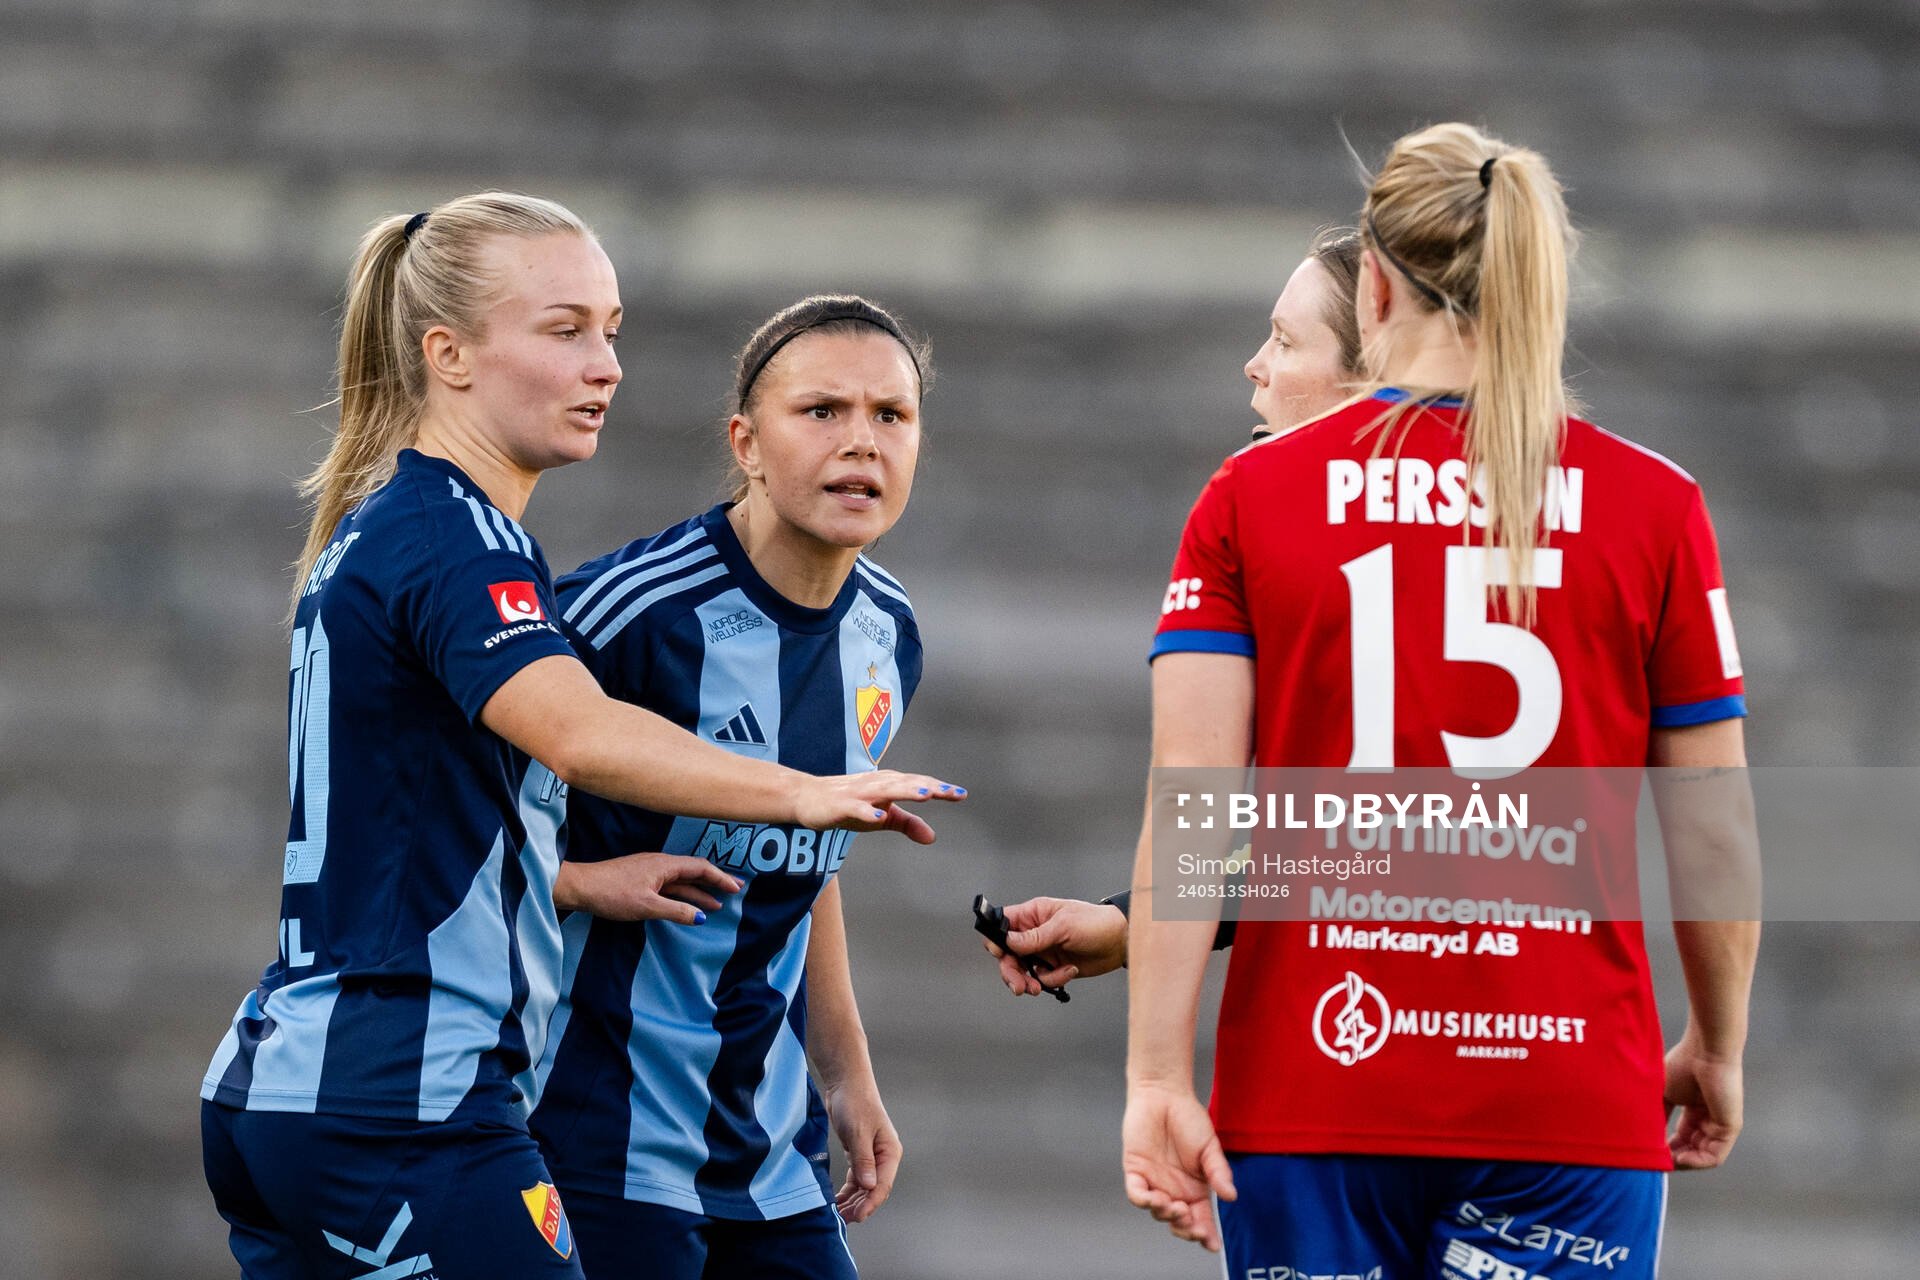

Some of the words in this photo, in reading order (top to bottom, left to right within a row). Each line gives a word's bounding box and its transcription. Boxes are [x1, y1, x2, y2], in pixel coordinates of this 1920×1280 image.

[1327, 458, 1584, 533] PERSSN
[484, 622, 547, 648] SVENSKA
[707, 617, 763, 644] WELLNESS
[708, 610, 748, 631] NORDIC
[860, 610, 890, 640] NORDIC
[1340, 542, 1563, 780] 15
[1310, 886, 1592, 935] Motorcentrum
[1309, 924, 1318, 948] i
[1326, 925, 1468, 958] Markaryd
[1474, 932, 1519, 956] AB
[1392, 1009, 1586, 1043] MUSIKHUSET
